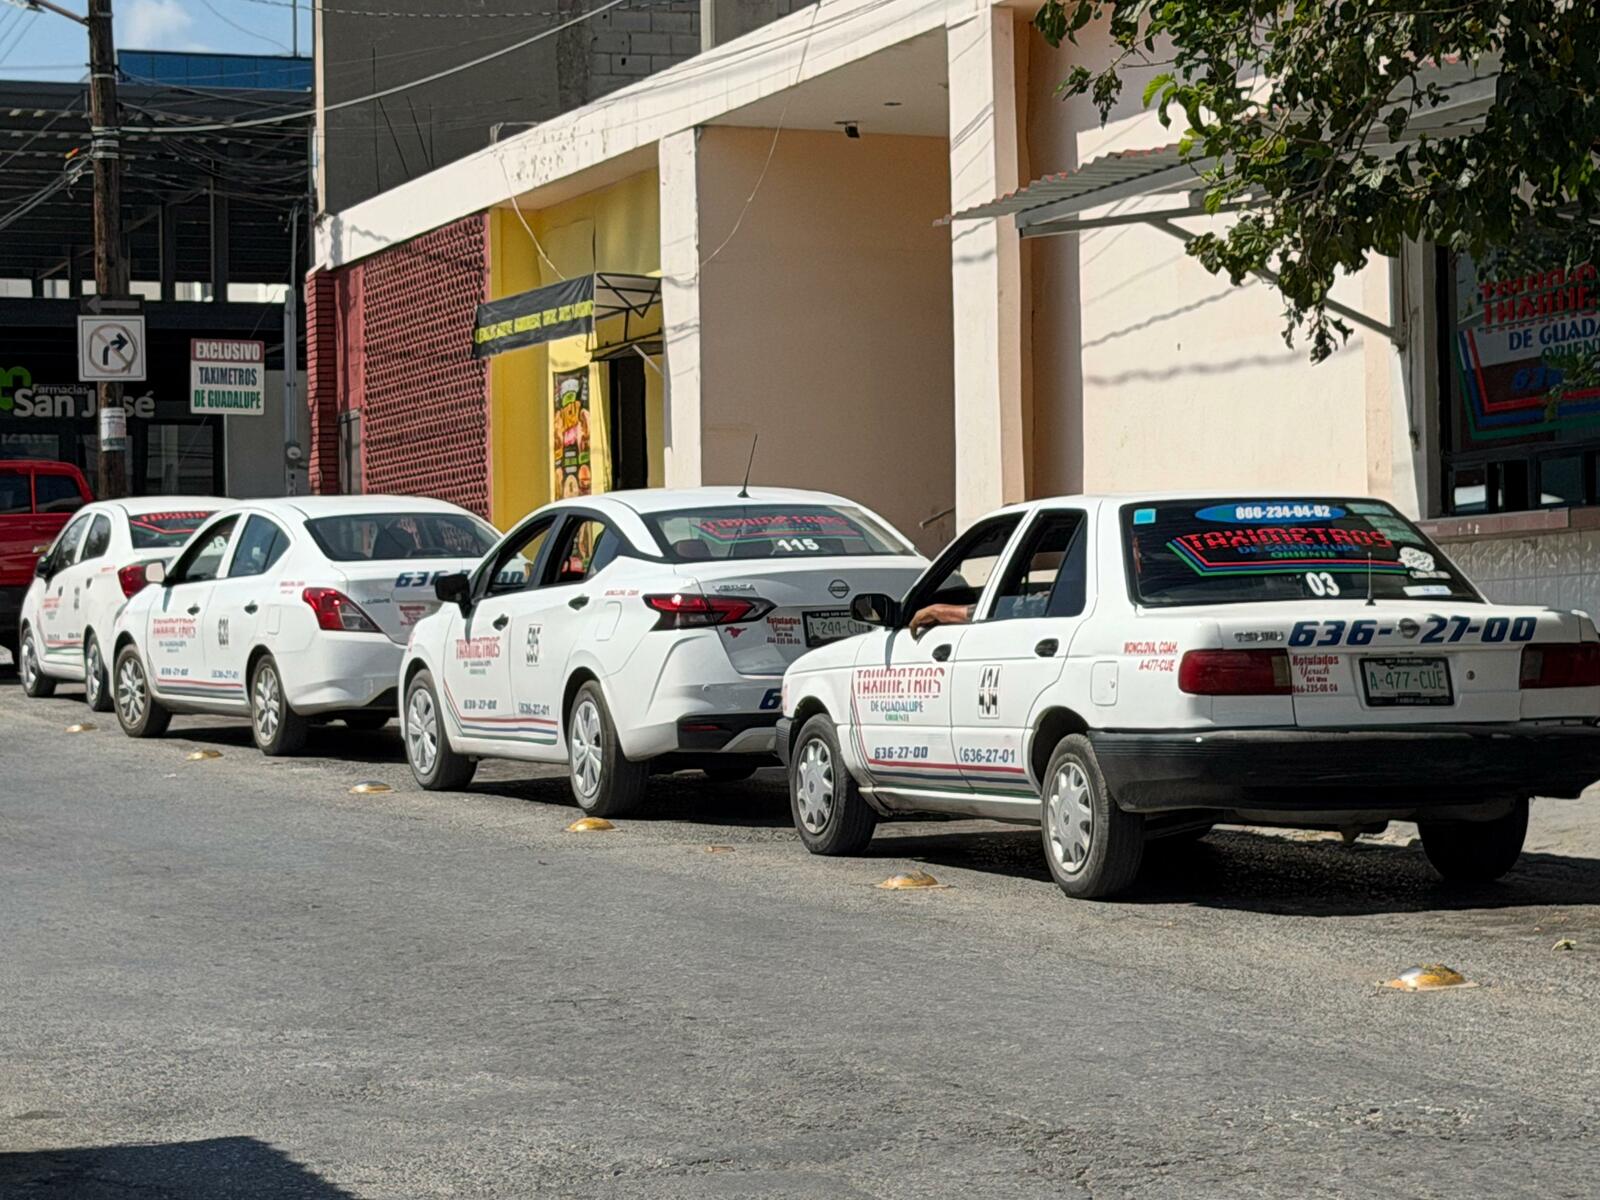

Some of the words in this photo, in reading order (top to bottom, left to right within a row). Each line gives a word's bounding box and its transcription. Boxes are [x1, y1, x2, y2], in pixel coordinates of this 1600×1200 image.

[1509, 329, 1533, 351] DE
[195, 341, 261, 361] EXCLUSIVO
[199, 366, 258, 386] TAXIMETROS
[32, 383, 89, 395] Farmacias
[194, 389, 206, 407] DE
[207, 389, 262, 409] GUADALUPE
[13, 388, 75, 418] San
[81, 389, 156, 418] Jsé
[776, 538, 820, 552] 115
[1183, 527, 1393, 550] TAXIMETROS
[1305, 572, 1341, 597] 03
[1138, 658, 1175, 672] A-477-CUE
[1369, 669, 1447, 691] A-477-CUE
[870, 700, 880, 713] DE
[880, 700, 924, 713] GUADALUPE
[874, 746, 928, 760] 636-27-00
